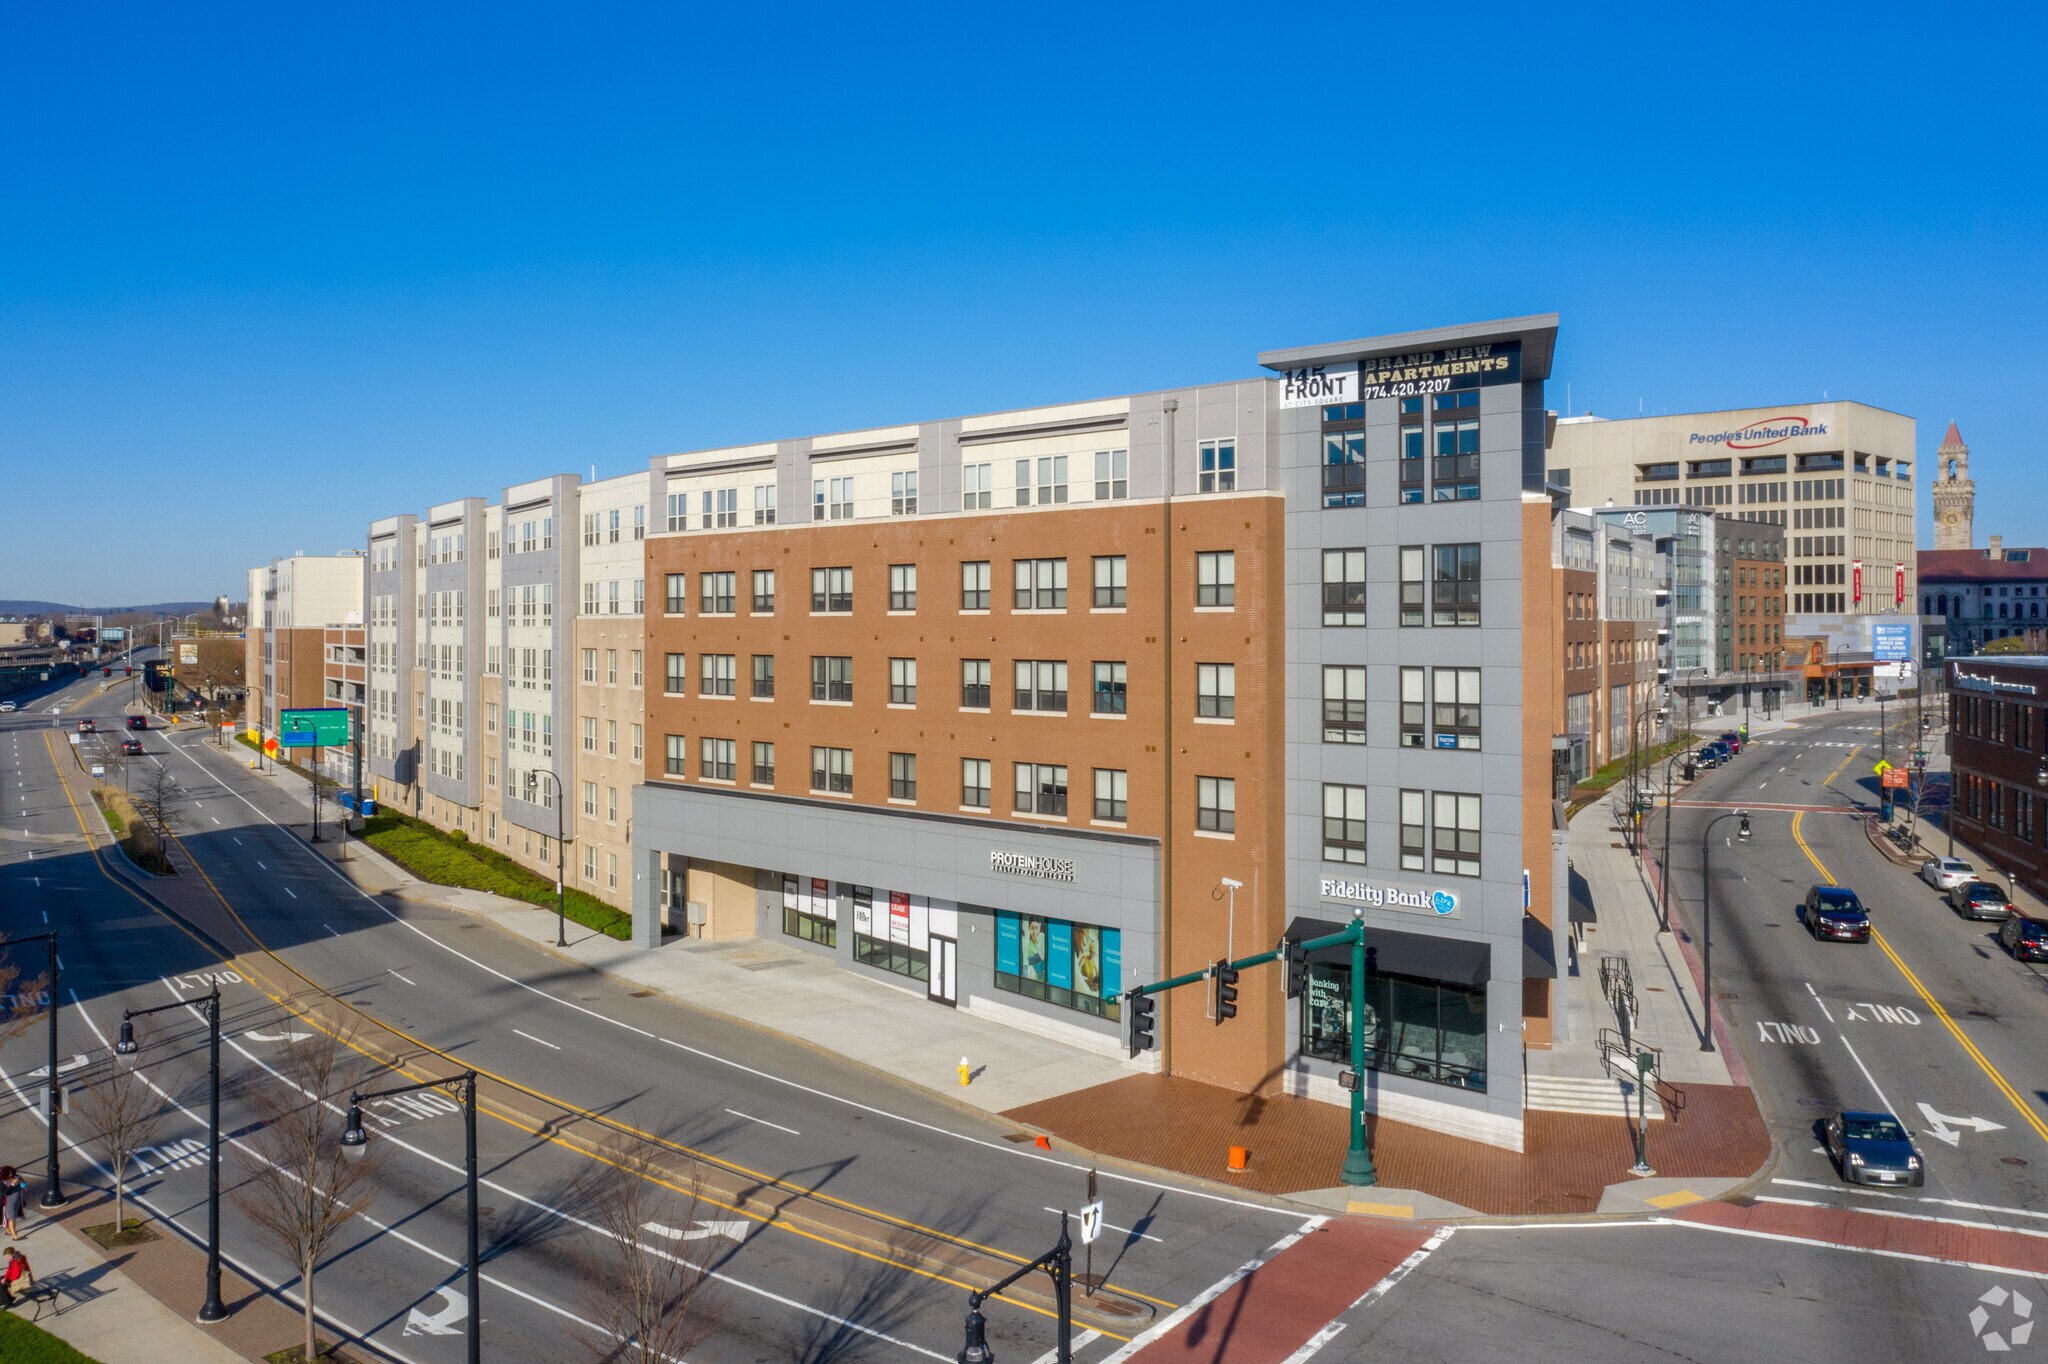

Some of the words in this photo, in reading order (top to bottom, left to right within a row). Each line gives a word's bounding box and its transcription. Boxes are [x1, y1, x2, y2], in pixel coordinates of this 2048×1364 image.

[1365, 352, 1435, 371] BRAND
[1444, 345, 1492, 361] NEW
[1285, 365, 1327, 387] 145
[1365, 357, 1509, 385] APARTMENTS
[1285, 376, 1346, 400] FRONT
[1365, 378, 1451, 399] 774.420.2207
[1315, 396, 1344, 405] SQUARE
[1689, 430, 1742, 445] People's
[1744, 427, 1788, 440] United
[1790, 423, 1827, 437] Bank
[1623, 512, 1647, 525] AC
[991, 851, 1074, 874] PROTEINHOUSE
[1321, 880, 1383, 907] Fidelity
[1386, 888, 1432, 909] Bank
[892, 903, 906, 913] LEASE
[174, 971, 243, 990] ONLY
[1310, 978, 1339, 992] Banking
[1310, 989, 1326, 998] with
[1847, 1003, 1921, 1026] ONLY
[1756, 1021, 1821, 1044] ONLY
